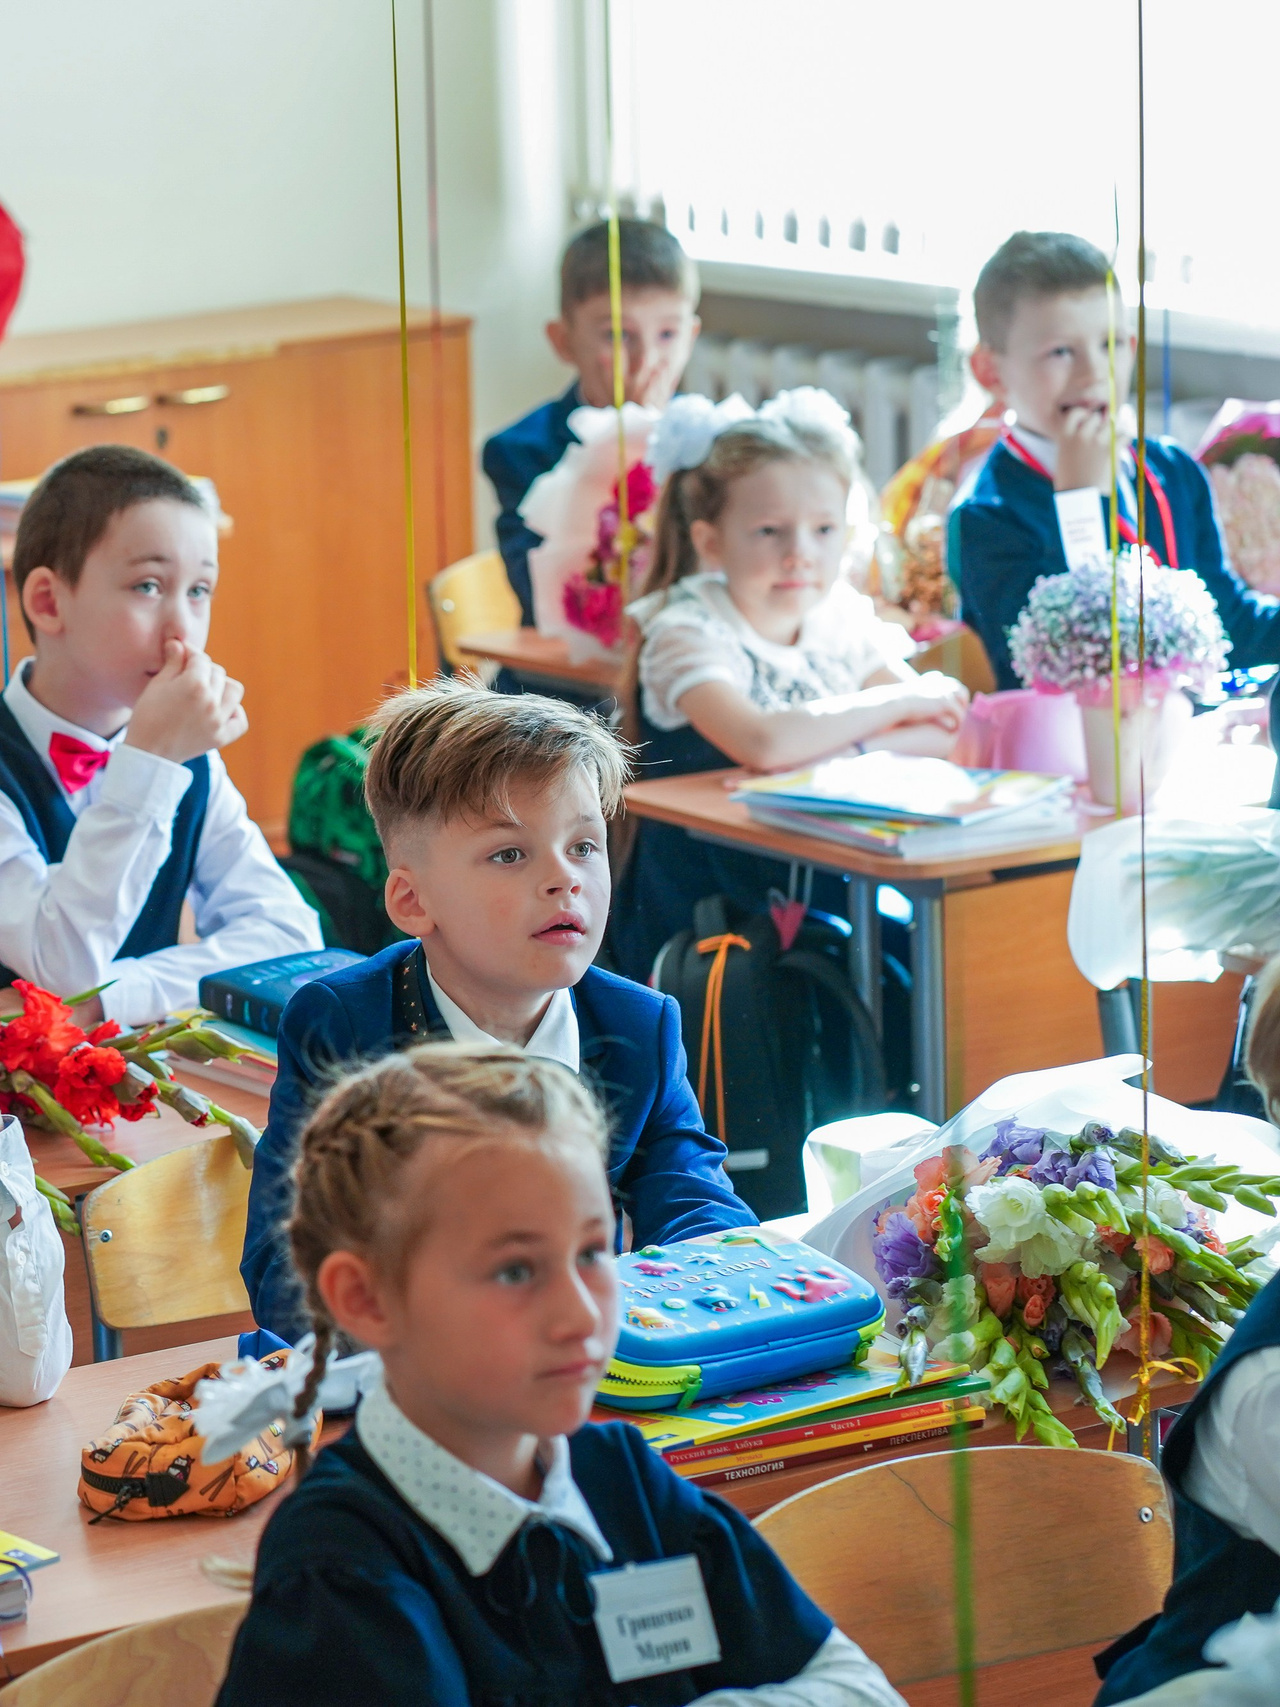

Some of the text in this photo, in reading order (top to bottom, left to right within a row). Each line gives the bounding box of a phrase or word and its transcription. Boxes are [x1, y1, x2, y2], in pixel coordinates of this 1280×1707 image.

[681, 1258, 772, 1284] Amaze
[830, 1420, 855, 1431] Часть
[889, 1426, 949, 1446] ПЕРСПЕКТИВА
[670, 1446, 706, 1462] Русский
[734, 1439, 764, 1451] Азбука
[724, 1461, 785, 1481] ТЕХНОЛОГИЯ
